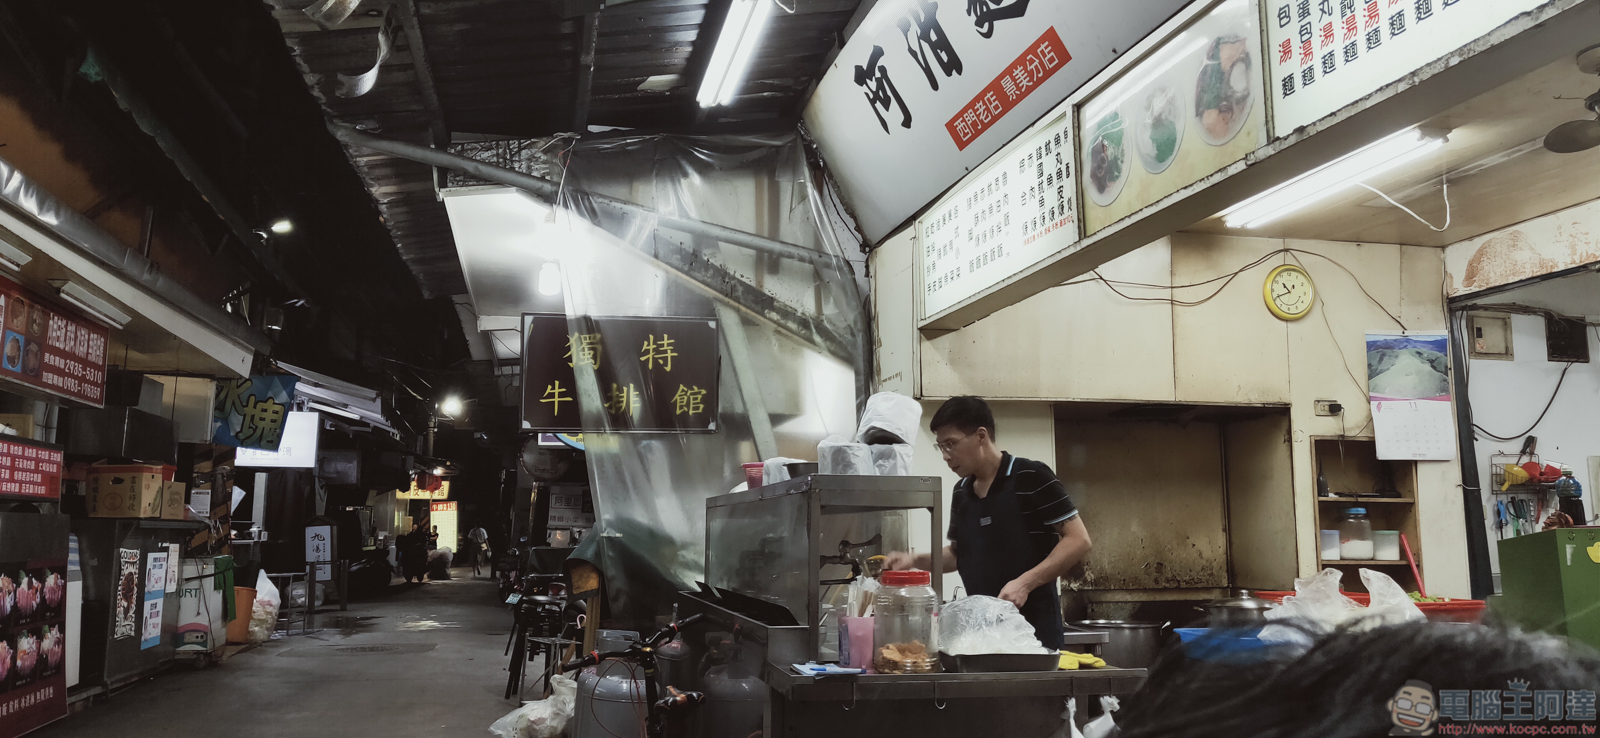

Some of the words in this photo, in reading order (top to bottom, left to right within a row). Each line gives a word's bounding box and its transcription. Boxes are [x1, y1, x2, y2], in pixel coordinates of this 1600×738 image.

[954, 90, 1003, 142] 西門老店
[1000, 41, 1059, 102] 景美分店
[562, 332, 679, 372] 獨特
[65, 359, 102, 384] 2935-5310
[538, 380, 707, 416] 牛排館
